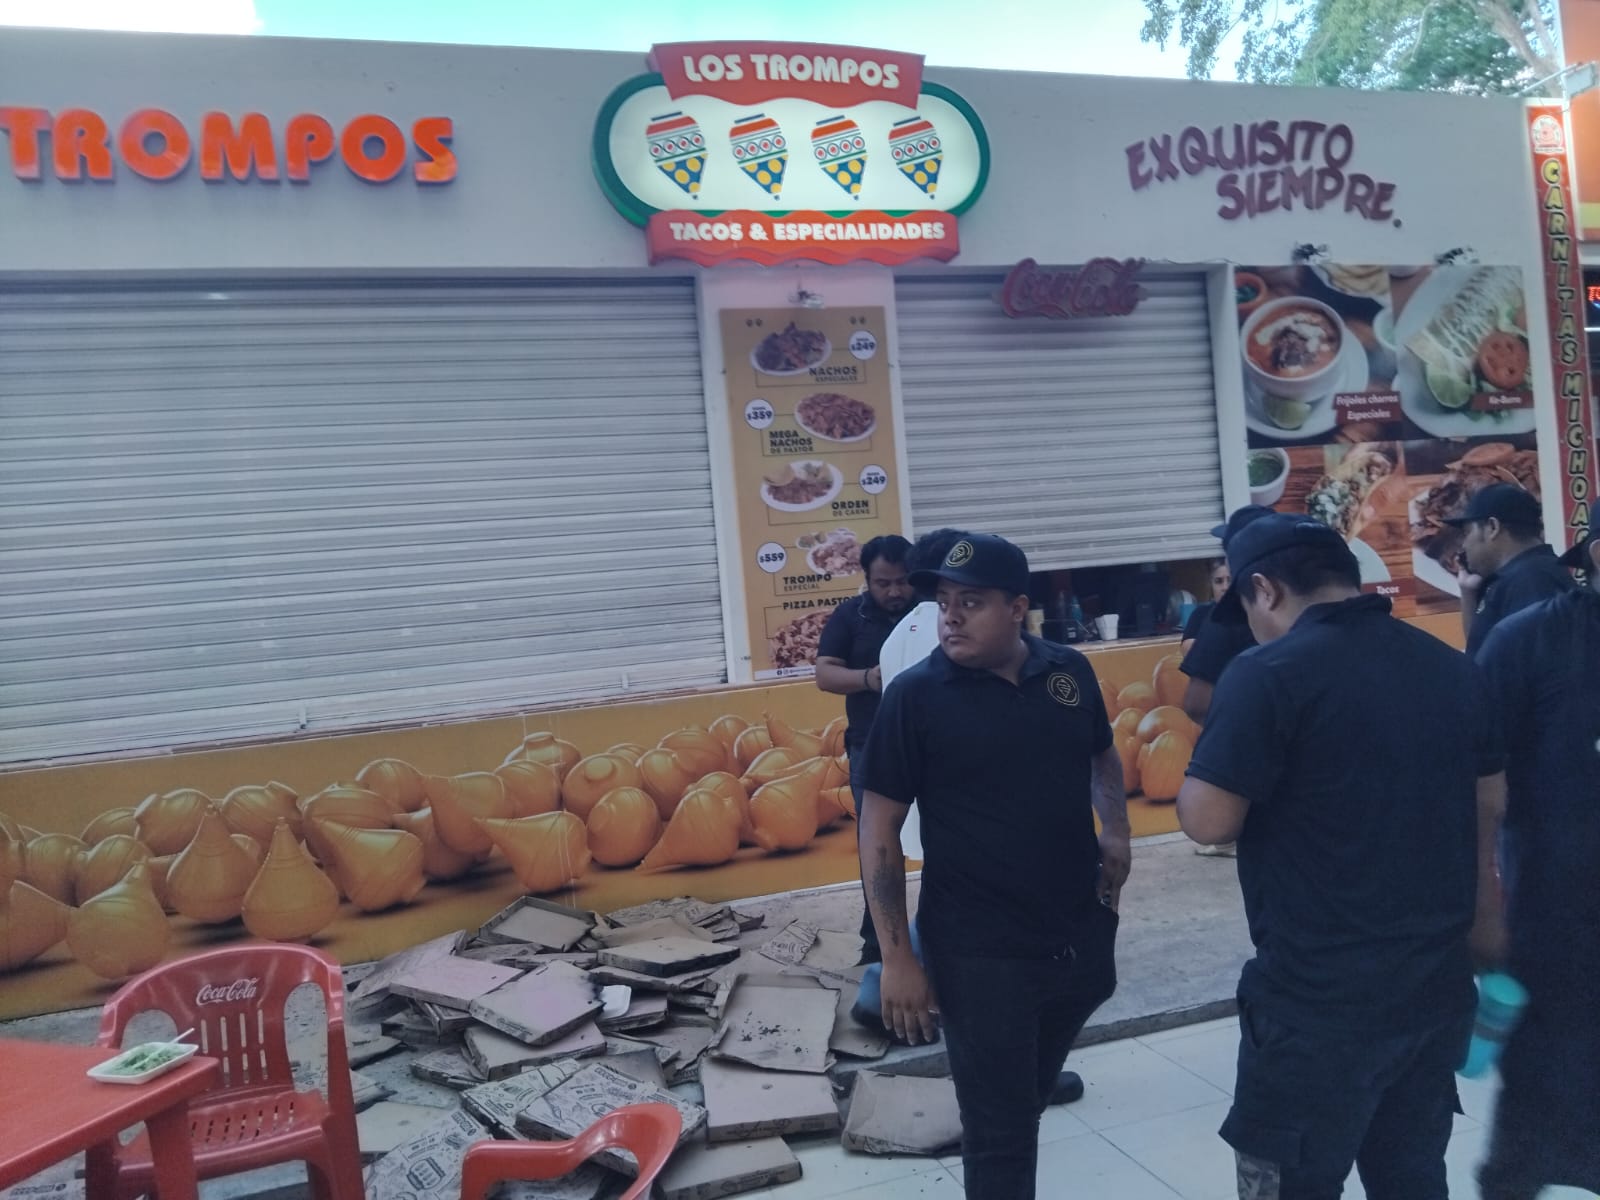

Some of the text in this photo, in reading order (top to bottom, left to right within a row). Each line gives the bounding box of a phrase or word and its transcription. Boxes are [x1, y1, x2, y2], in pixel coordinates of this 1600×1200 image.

[683, 54, 900, 89] LOS TROMPOS
[0, 106, 458, 185] TROMPOS
[1125, 120, 1354, 192] EXQUISITO
[1217, 165, 1403, 228] SIEMPRE.
[669, 221, 946, 241] TACOS & ESPECIALIDADES
[1541, 158, 1579, 366] CARNITAS
[851, 342, 876, 351] $249
[808, 366, 857, 376] NACHOS
[747, 410, 772, 420] $359
[769, 429, 799, 438] MEGA
[770, 437, 812, 447] NACHOS
[862, 475, 886, 485] $249
[832, 500, 869, 509] ORDEN
[760, 552, 784, 563] $559
[783, 573, 832, 584] TROMPO
[784, 583, 819, 592] ESPECIAL
[1375, 585, 1400, 594] Tacos
[783, 600, 815, 610] PIZZA
